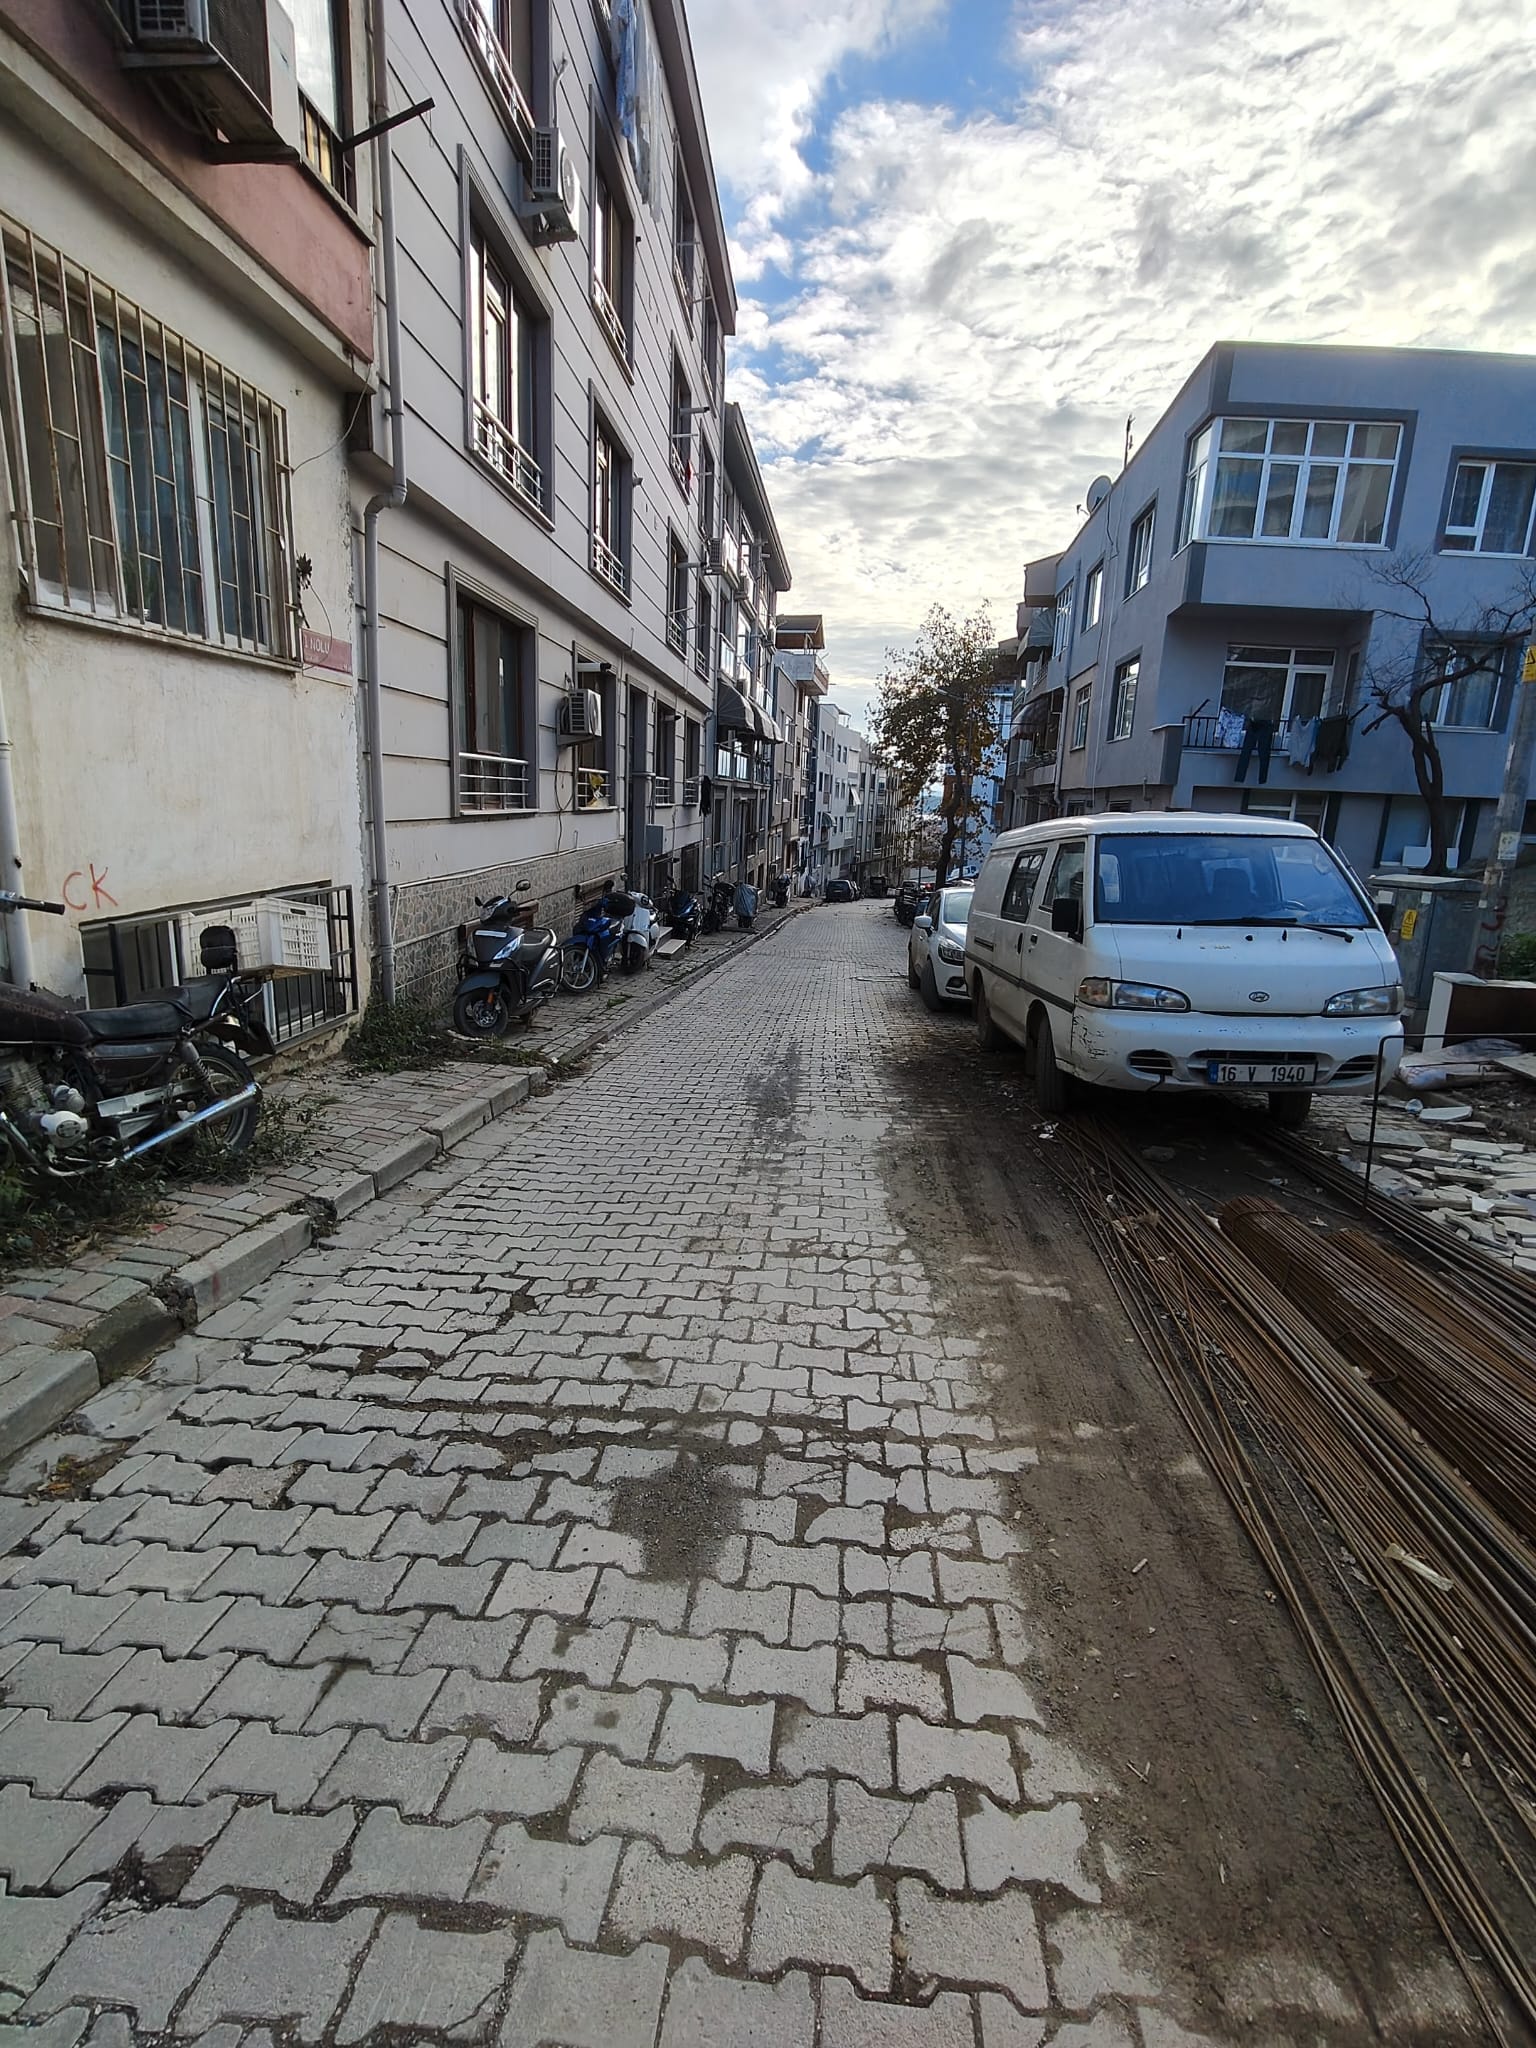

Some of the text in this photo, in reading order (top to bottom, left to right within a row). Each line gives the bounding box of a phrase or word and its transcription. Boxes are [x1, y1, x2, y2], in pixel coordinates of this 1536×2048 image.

[310, 637, 330, 655] NOLU
[62, 863, 118, 911] CK
[1220, 1065, 1237, 1081] 16
[1247, 1066, 1257, 1082] V
[1271, 1066, 1305, 1082] 1940
